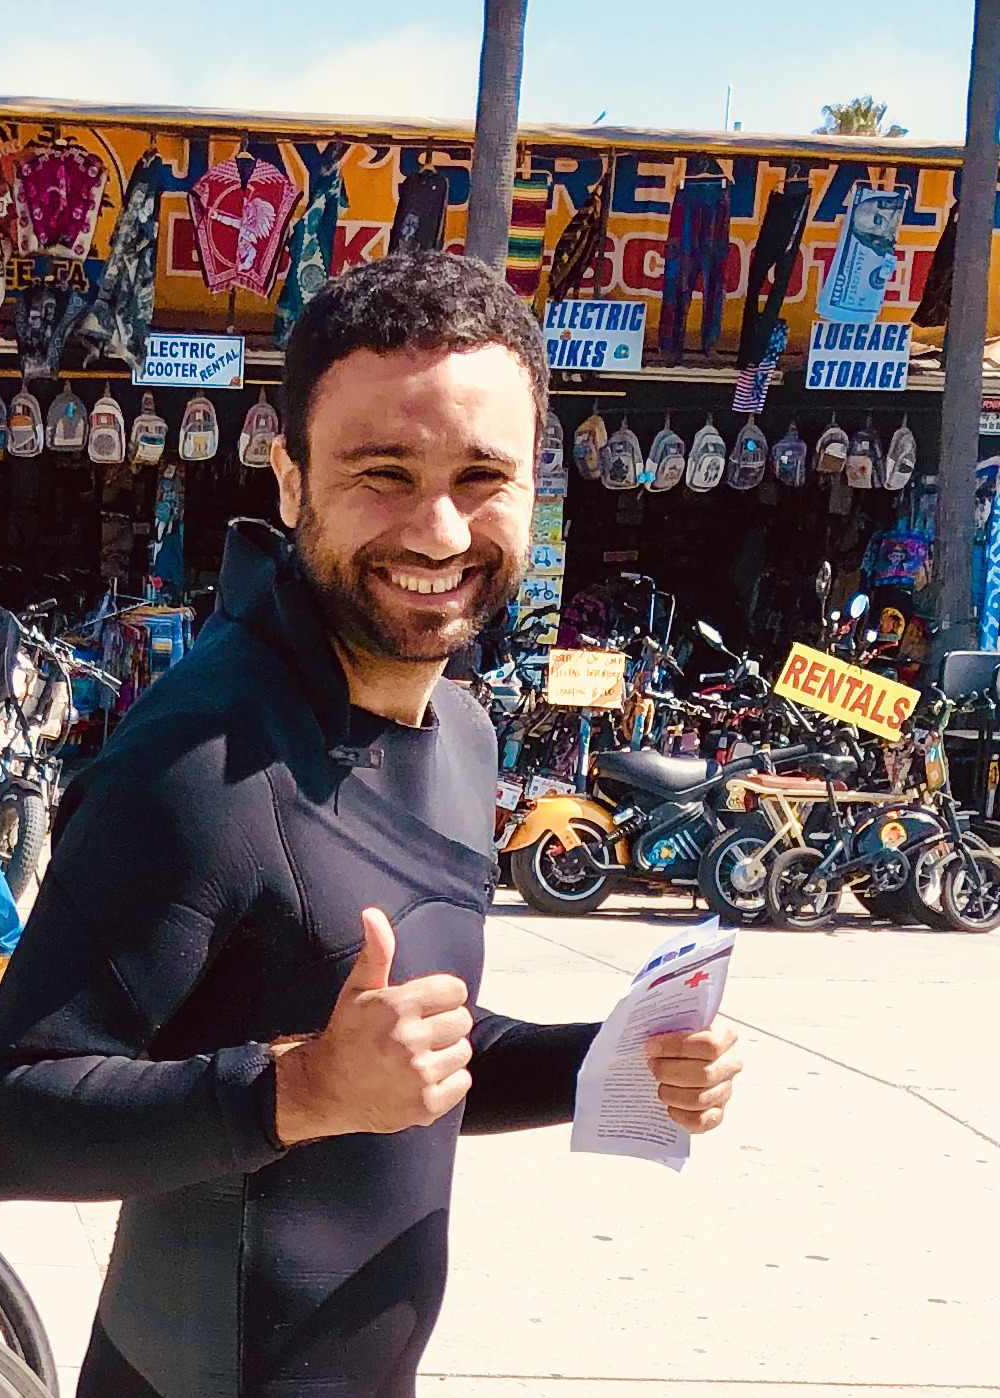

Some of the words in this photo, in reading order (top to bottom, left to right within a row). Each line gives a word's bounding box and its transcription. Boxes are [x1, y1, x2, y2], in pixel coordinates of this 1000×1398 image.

[546, 301, 646, 331] ELECTRIC
[150, 340, 217, 360] LECTRIC
[812, 323, 911, 352] LUGGAGE
[199, 348, 239, 383] RENTAL
[546, 339, 608, 368] BIKES
[146, 361, 198, 378] COOTER
[808, 360, 907, 389] STORAGE
[782, 654, 911, 730] RENTALS
